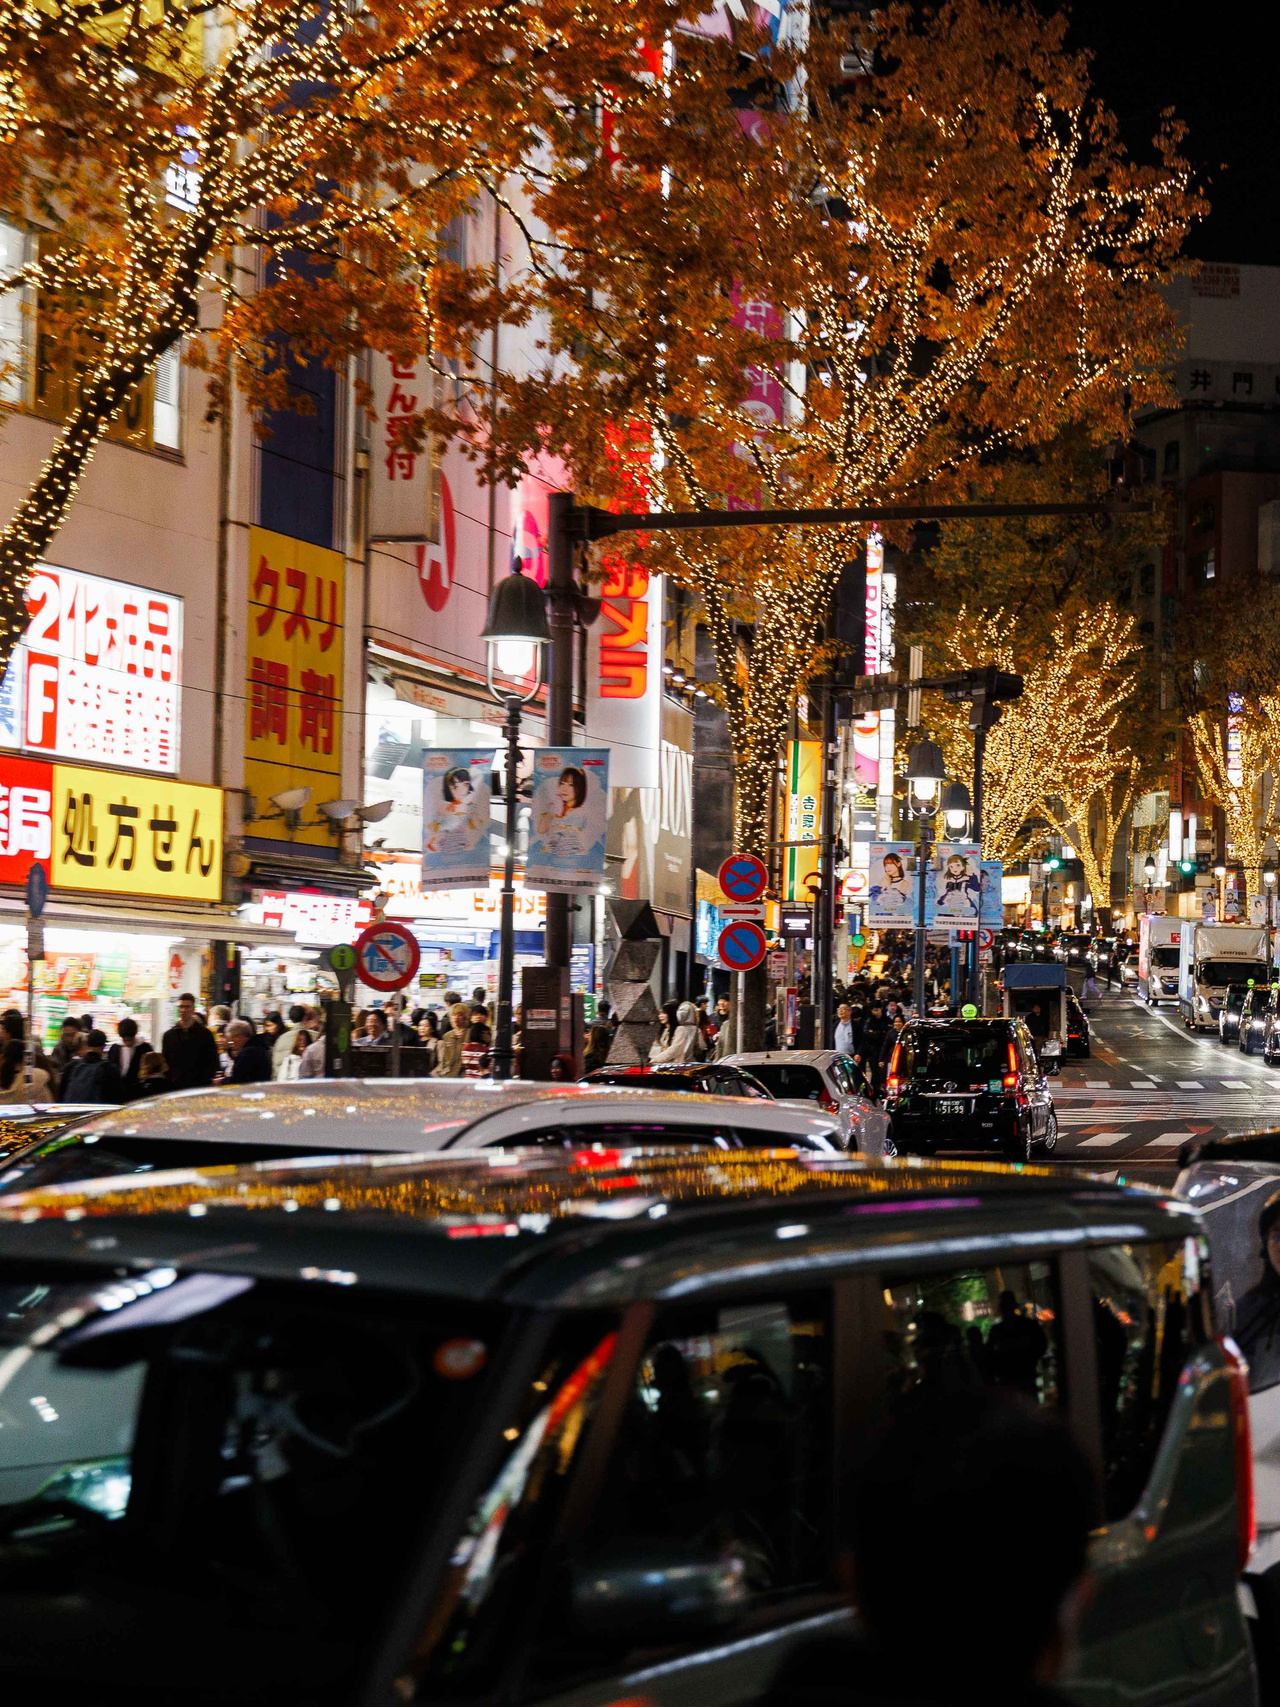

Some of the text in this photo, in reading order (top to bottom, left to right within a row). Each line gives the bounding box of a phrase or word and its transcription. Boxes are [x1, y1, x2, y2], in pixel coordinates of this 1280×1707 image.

[252, 554, 337, 653] クスリ
[249, 656, 335, 755] 調剤
[62, 788, 216, 879] 処方せん
[941, 1105, 965, 1115] 51-99
